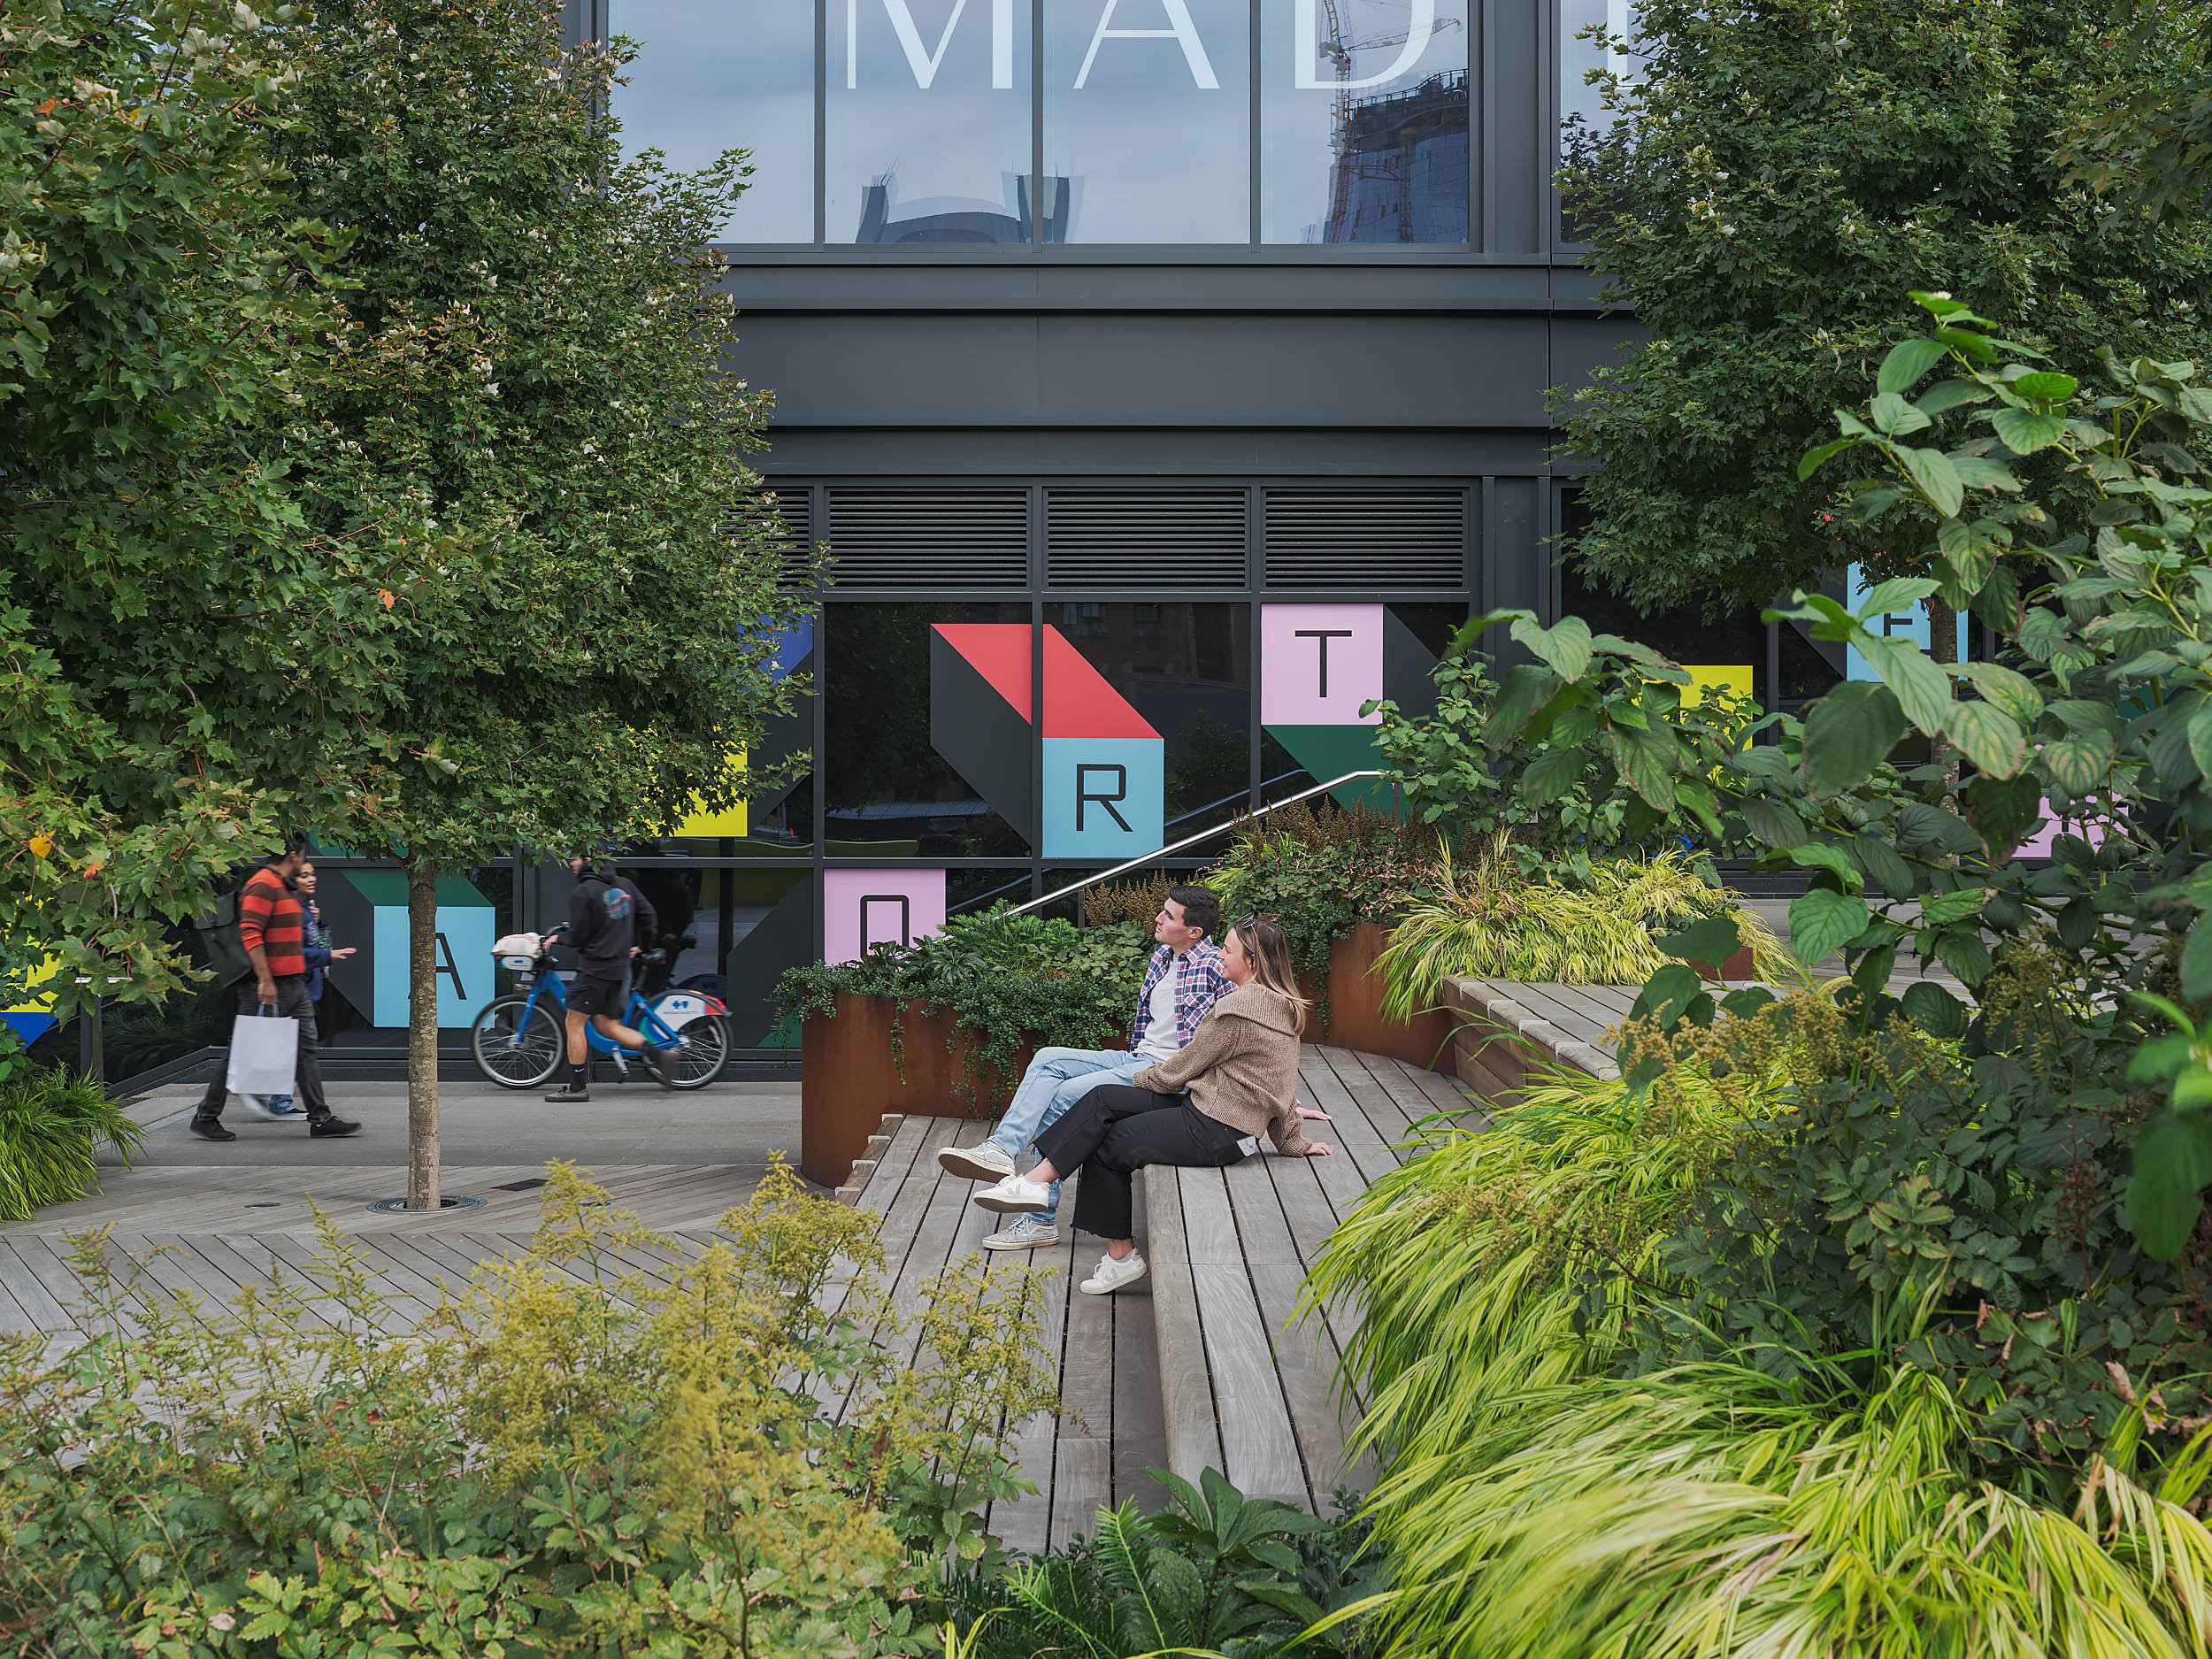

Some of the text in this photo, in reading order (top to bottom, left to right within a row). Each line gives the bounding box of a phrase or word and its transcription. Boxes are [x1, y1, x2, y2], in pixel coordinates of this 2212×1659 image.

[1294, 630, 1353, 698] T
[1076, 764, 1133, 833] R
[408, 933, 467, 1000] A
